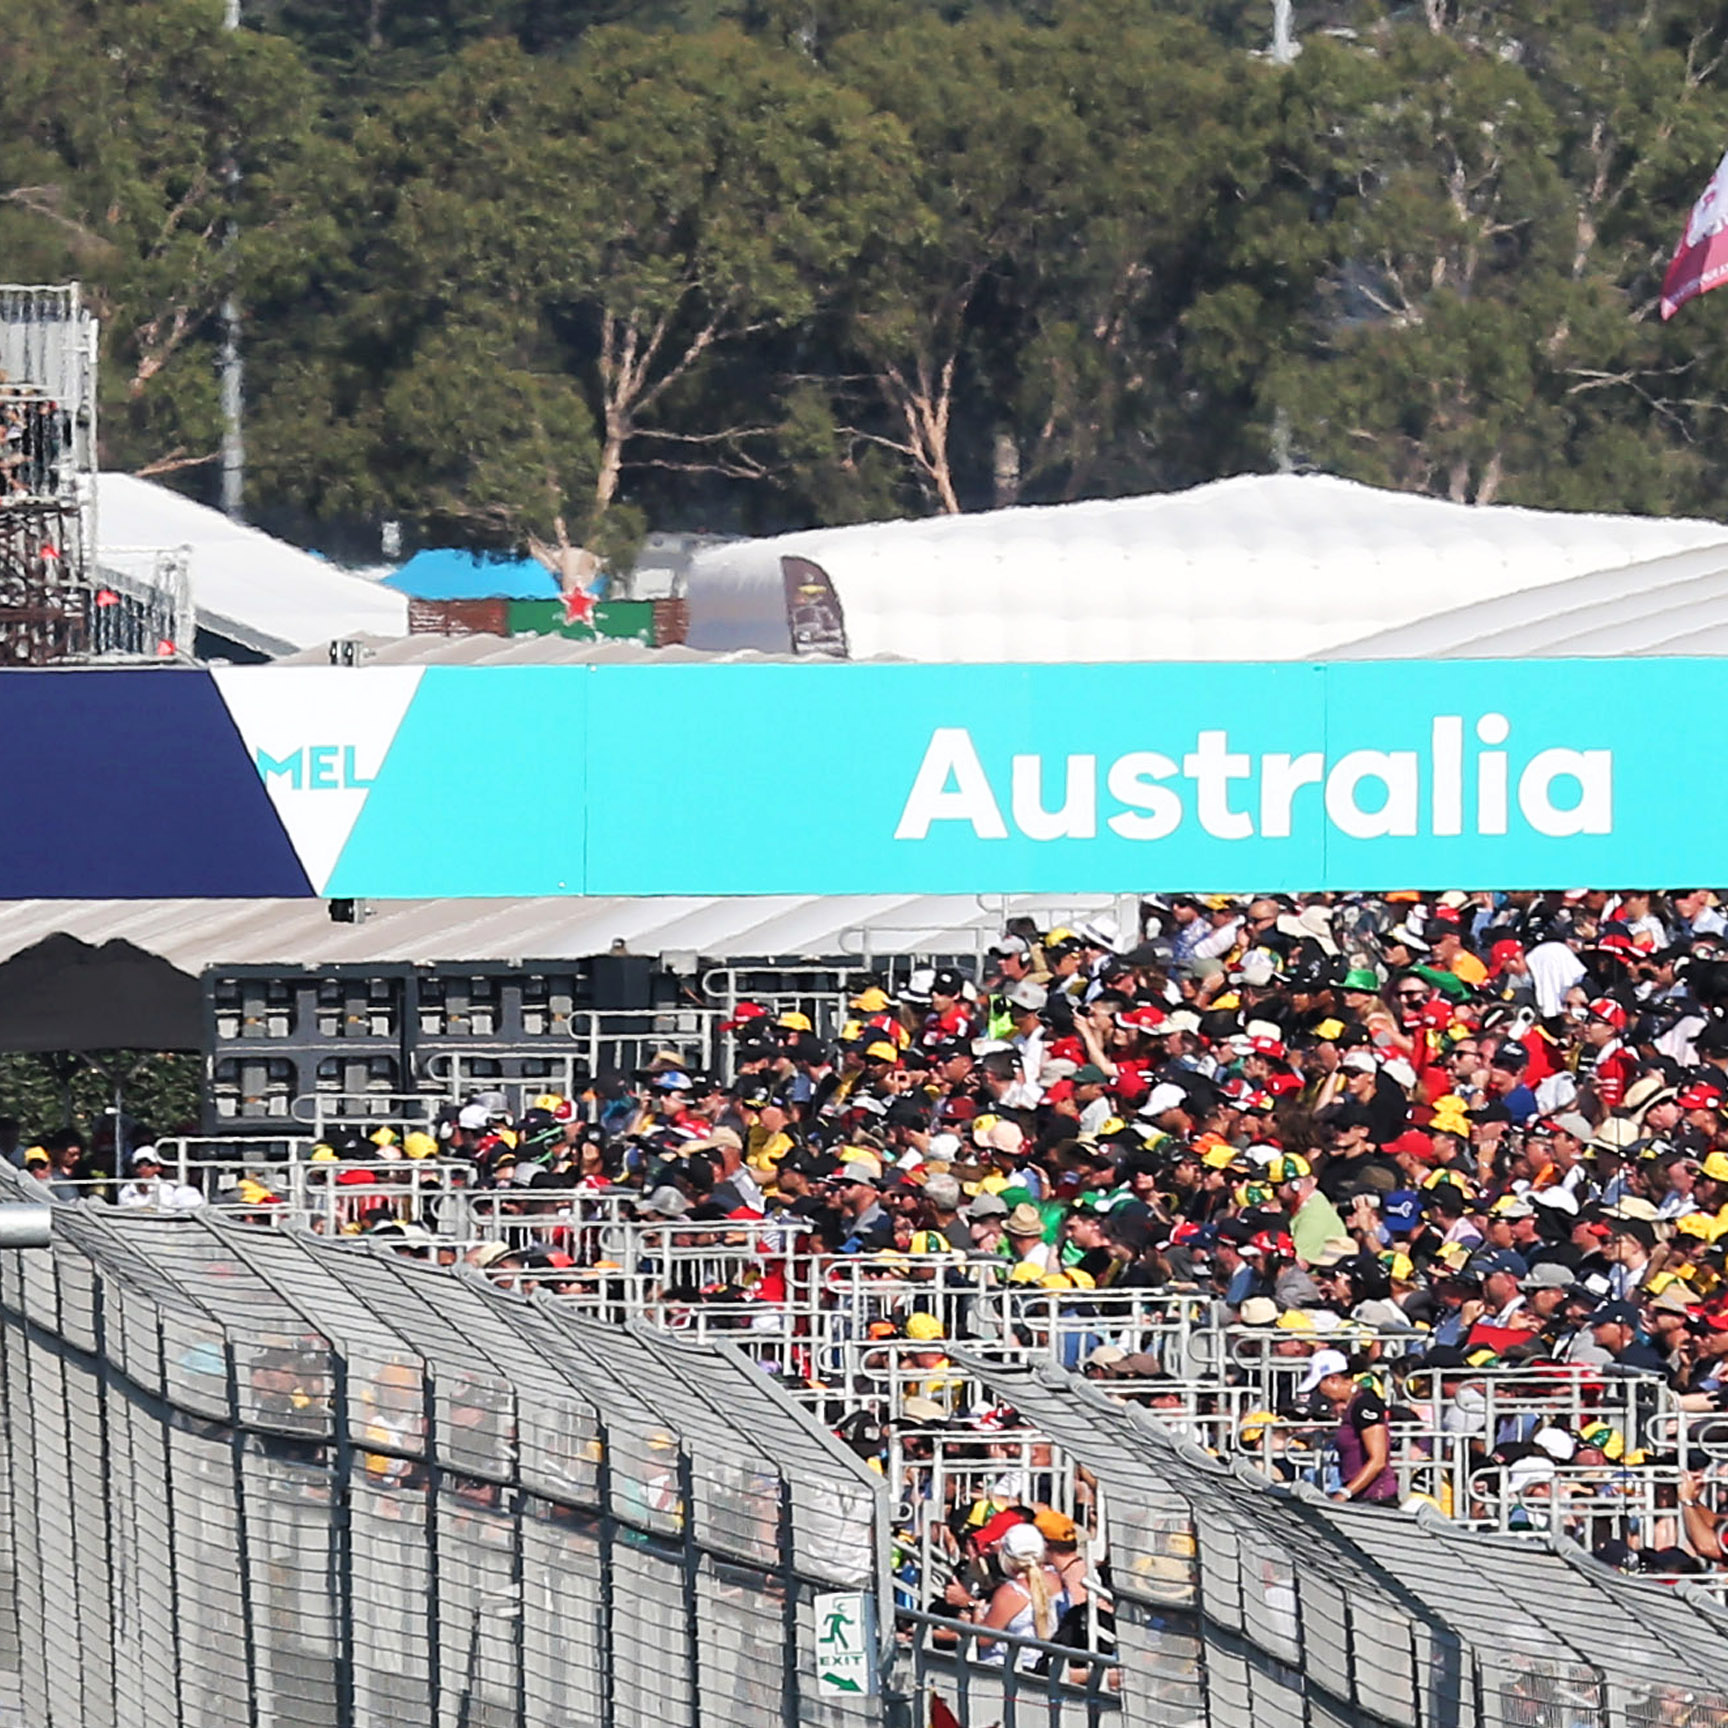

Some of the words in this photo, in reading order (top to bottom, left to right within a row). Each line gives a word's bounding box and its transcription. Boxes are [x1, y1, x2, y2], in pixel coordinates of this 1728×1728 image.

[256, 744, 372, 791] MEL
[893, 712, 1614, 841] Australia
[819, 1655, 864, 1667] EXIT
